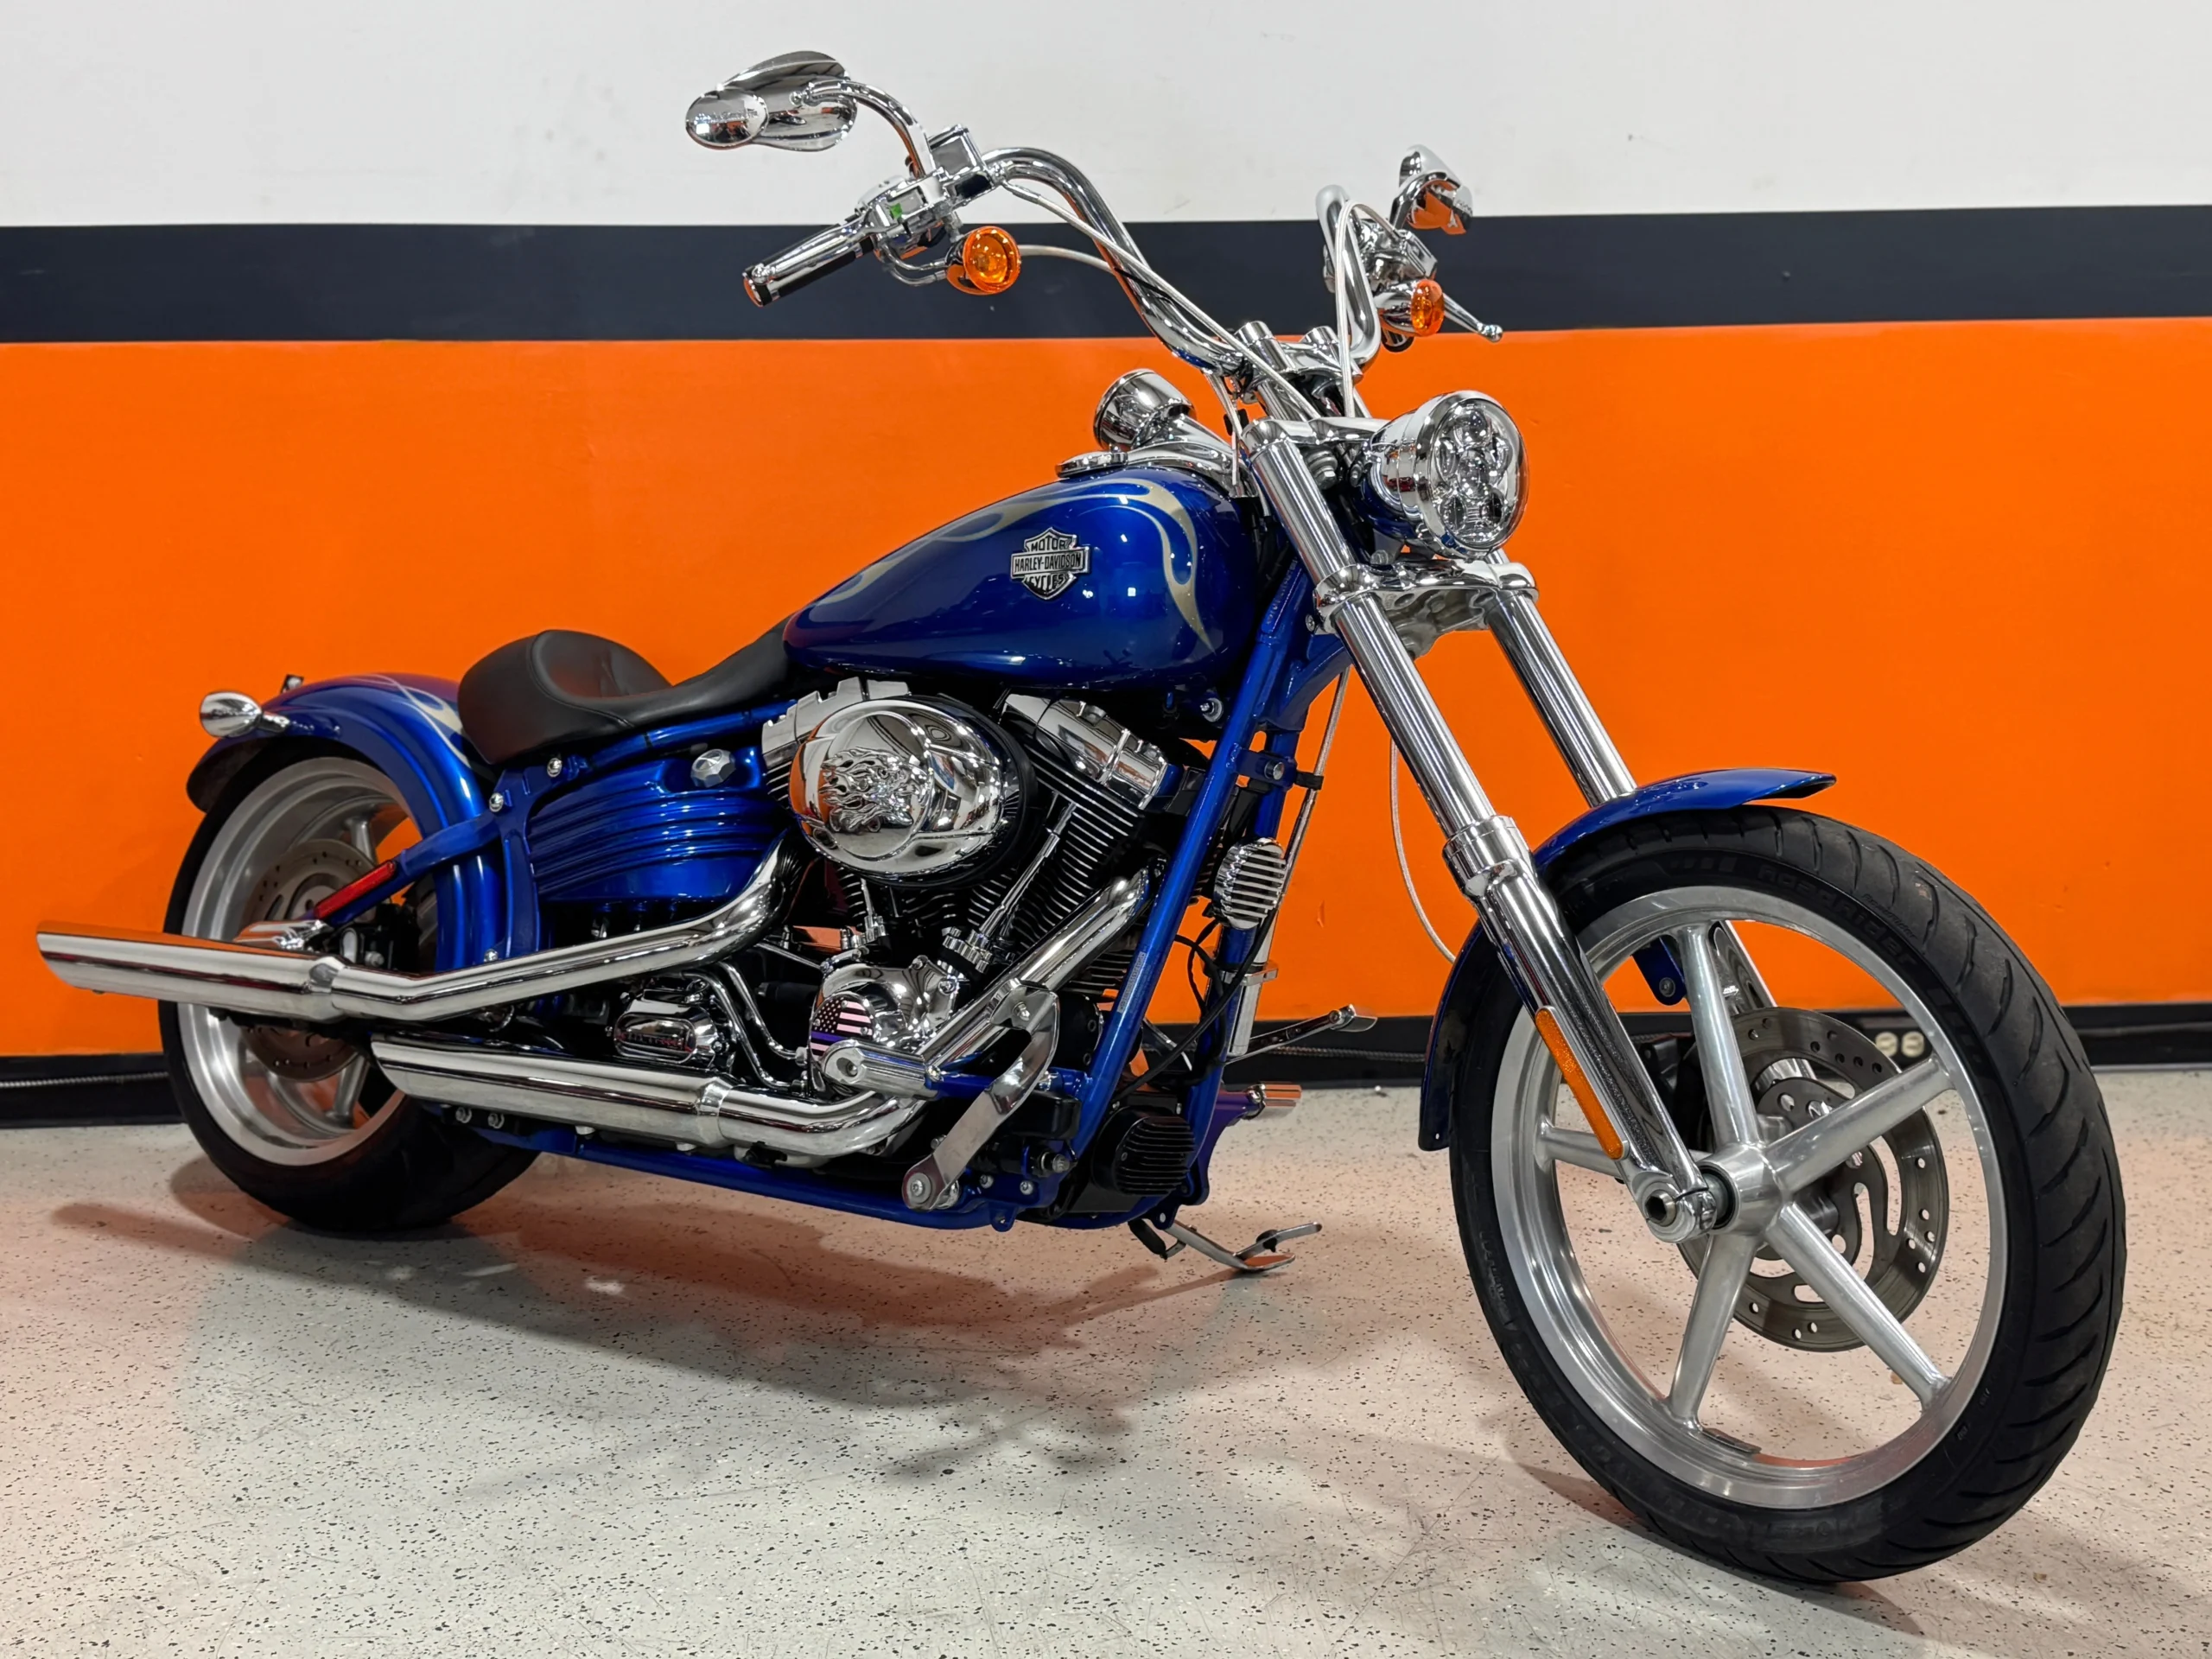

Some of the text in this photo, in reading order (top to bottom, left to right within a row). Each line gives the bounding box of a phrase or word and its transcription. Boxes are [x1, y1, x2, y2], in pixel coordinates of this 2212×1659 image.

[1031, 535, 1065, 552] MOTOR
[1014, 553, 1081, 572] HARLEY-DAVIDSON
[1027, 573, 1065, 592] CYCLES
